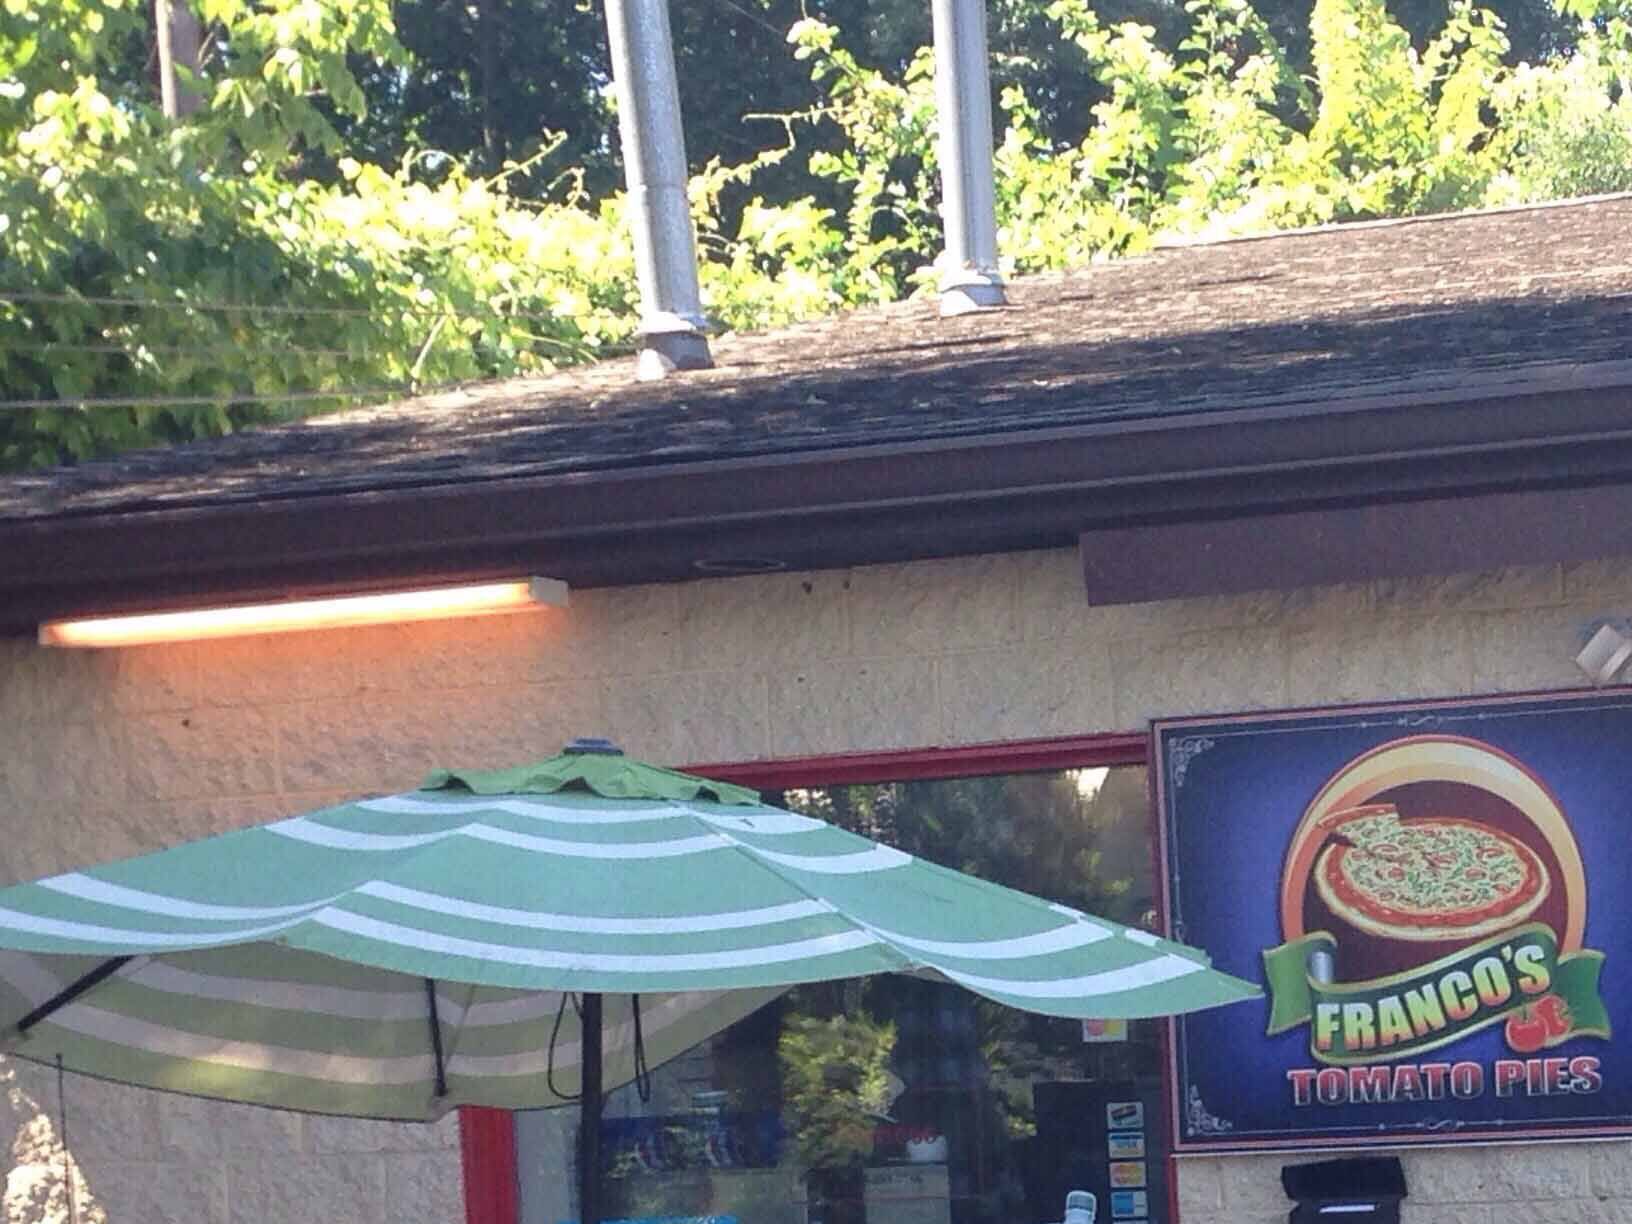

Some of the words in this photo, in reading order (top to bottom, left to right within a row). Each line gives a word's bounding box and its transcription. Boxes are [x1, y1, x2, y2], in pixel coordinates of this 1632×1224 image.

[1315, 944, 1552, 1051] FRANCO'S
[1287, 1060, 1485, 1107] TOMATO
[1494, 1056, 1603, 1098] PIES
